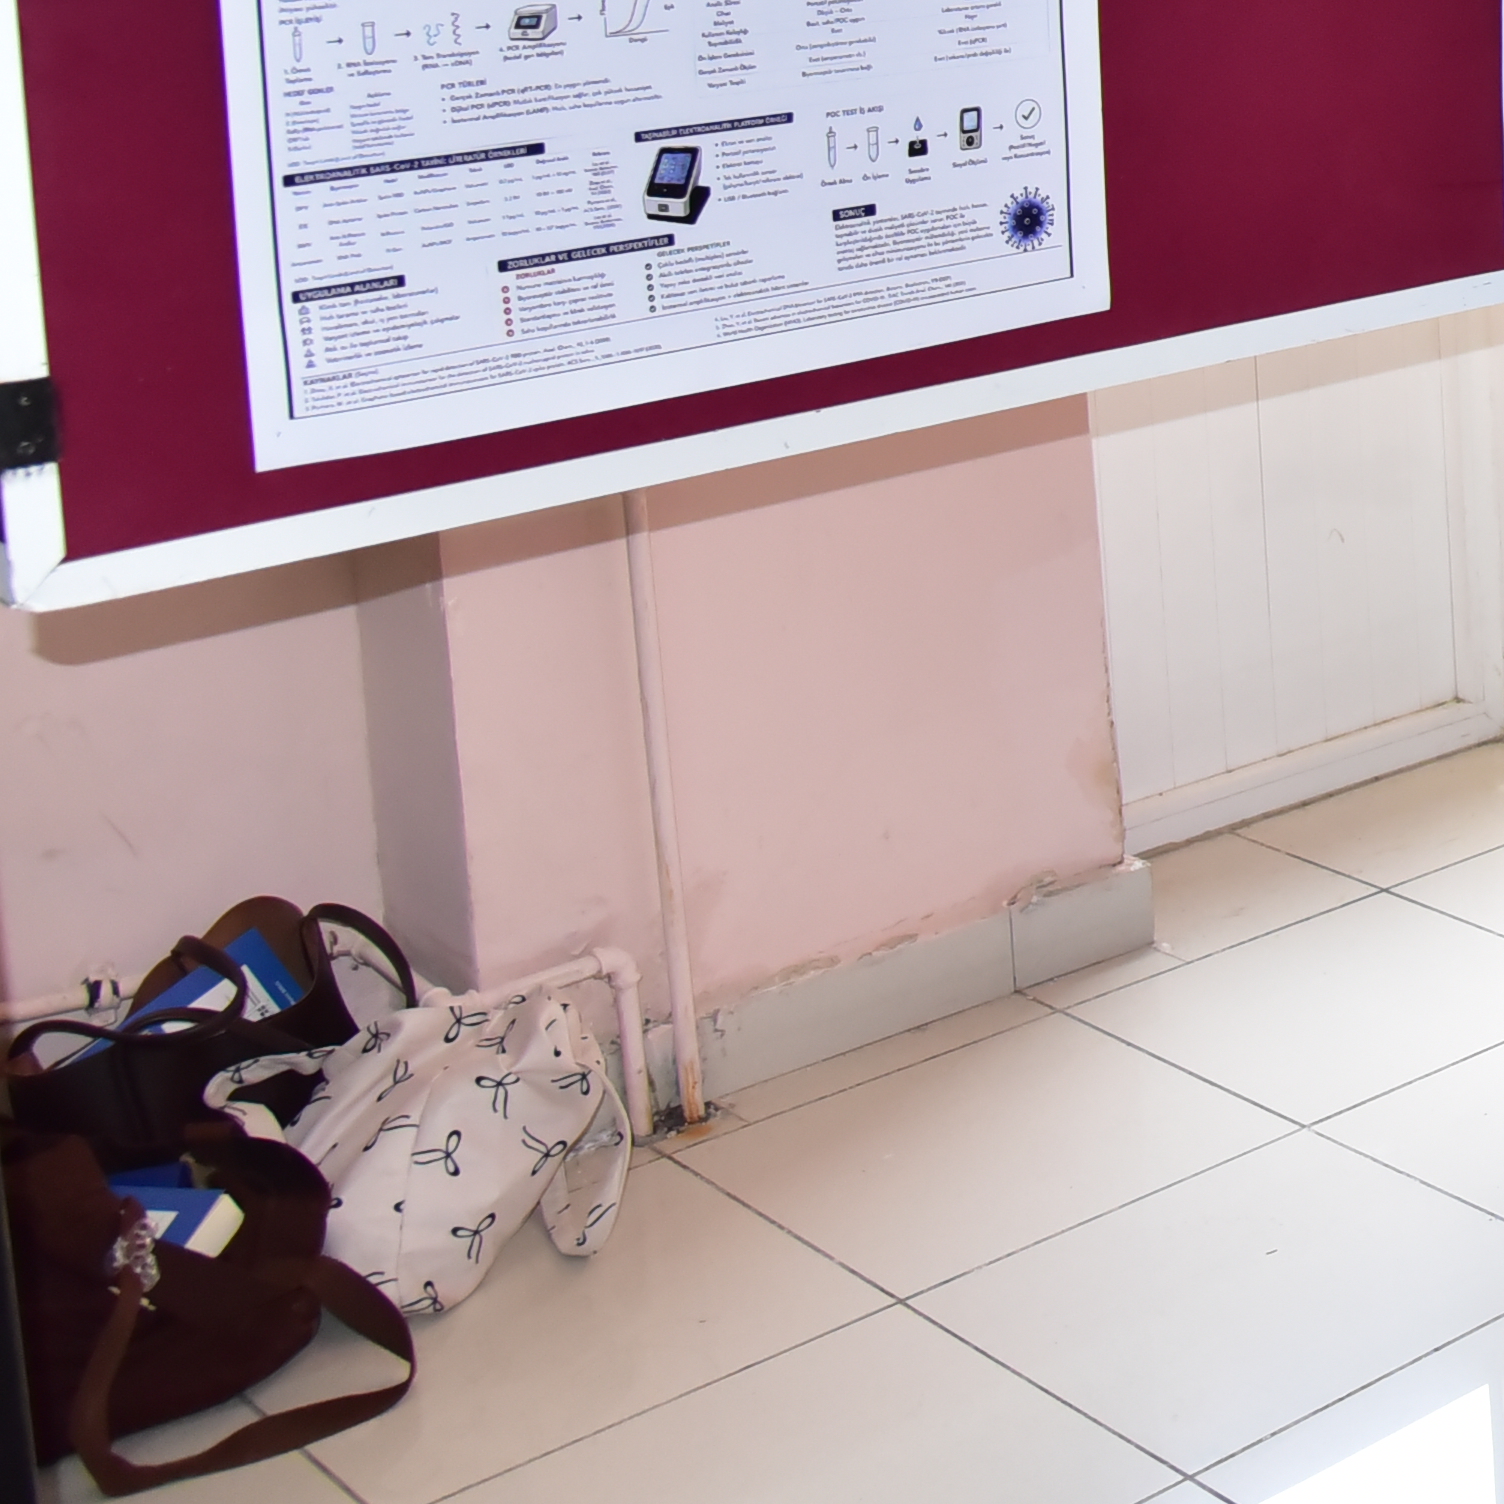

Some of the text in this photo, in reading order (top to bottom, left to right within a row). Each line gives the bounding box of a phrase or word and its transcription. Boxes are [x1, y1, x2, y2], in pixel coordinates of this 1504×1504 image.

[826, 110, 840, 119] POC
[842, 108, 857, 117] TEST
[838, 207, 865, 218] SONUÇ
[558, 252, 569, 261] VE
[571, 246, 607, 259] GELECEK
